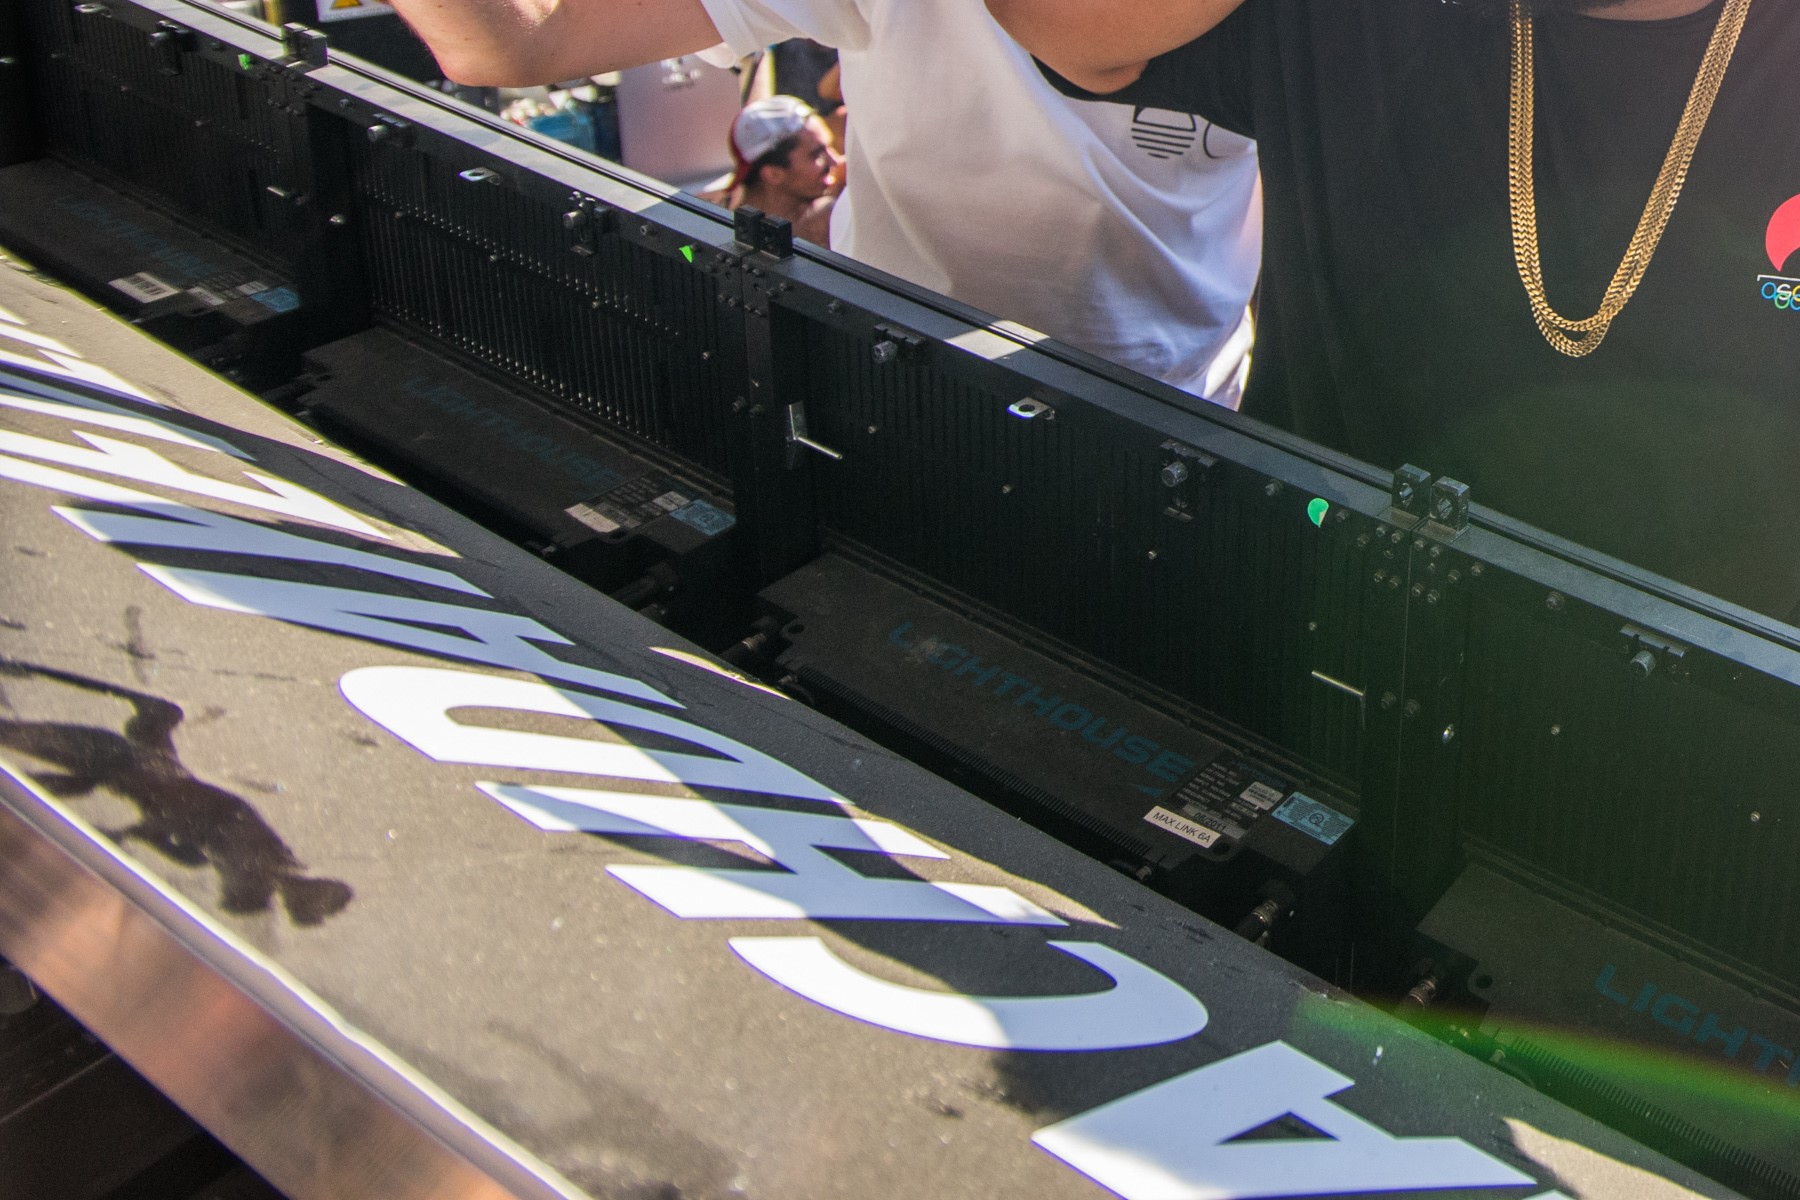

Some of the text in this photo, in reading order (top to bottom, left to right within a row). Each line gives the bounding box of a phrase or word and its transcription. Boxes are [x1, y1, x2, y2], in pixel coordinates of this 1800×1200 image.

[887, 621, 1198, 783] LGHTHOUSE
[1152, 812, 1174, 827] MAX
[1175, 820, 1200, 837] LINK
